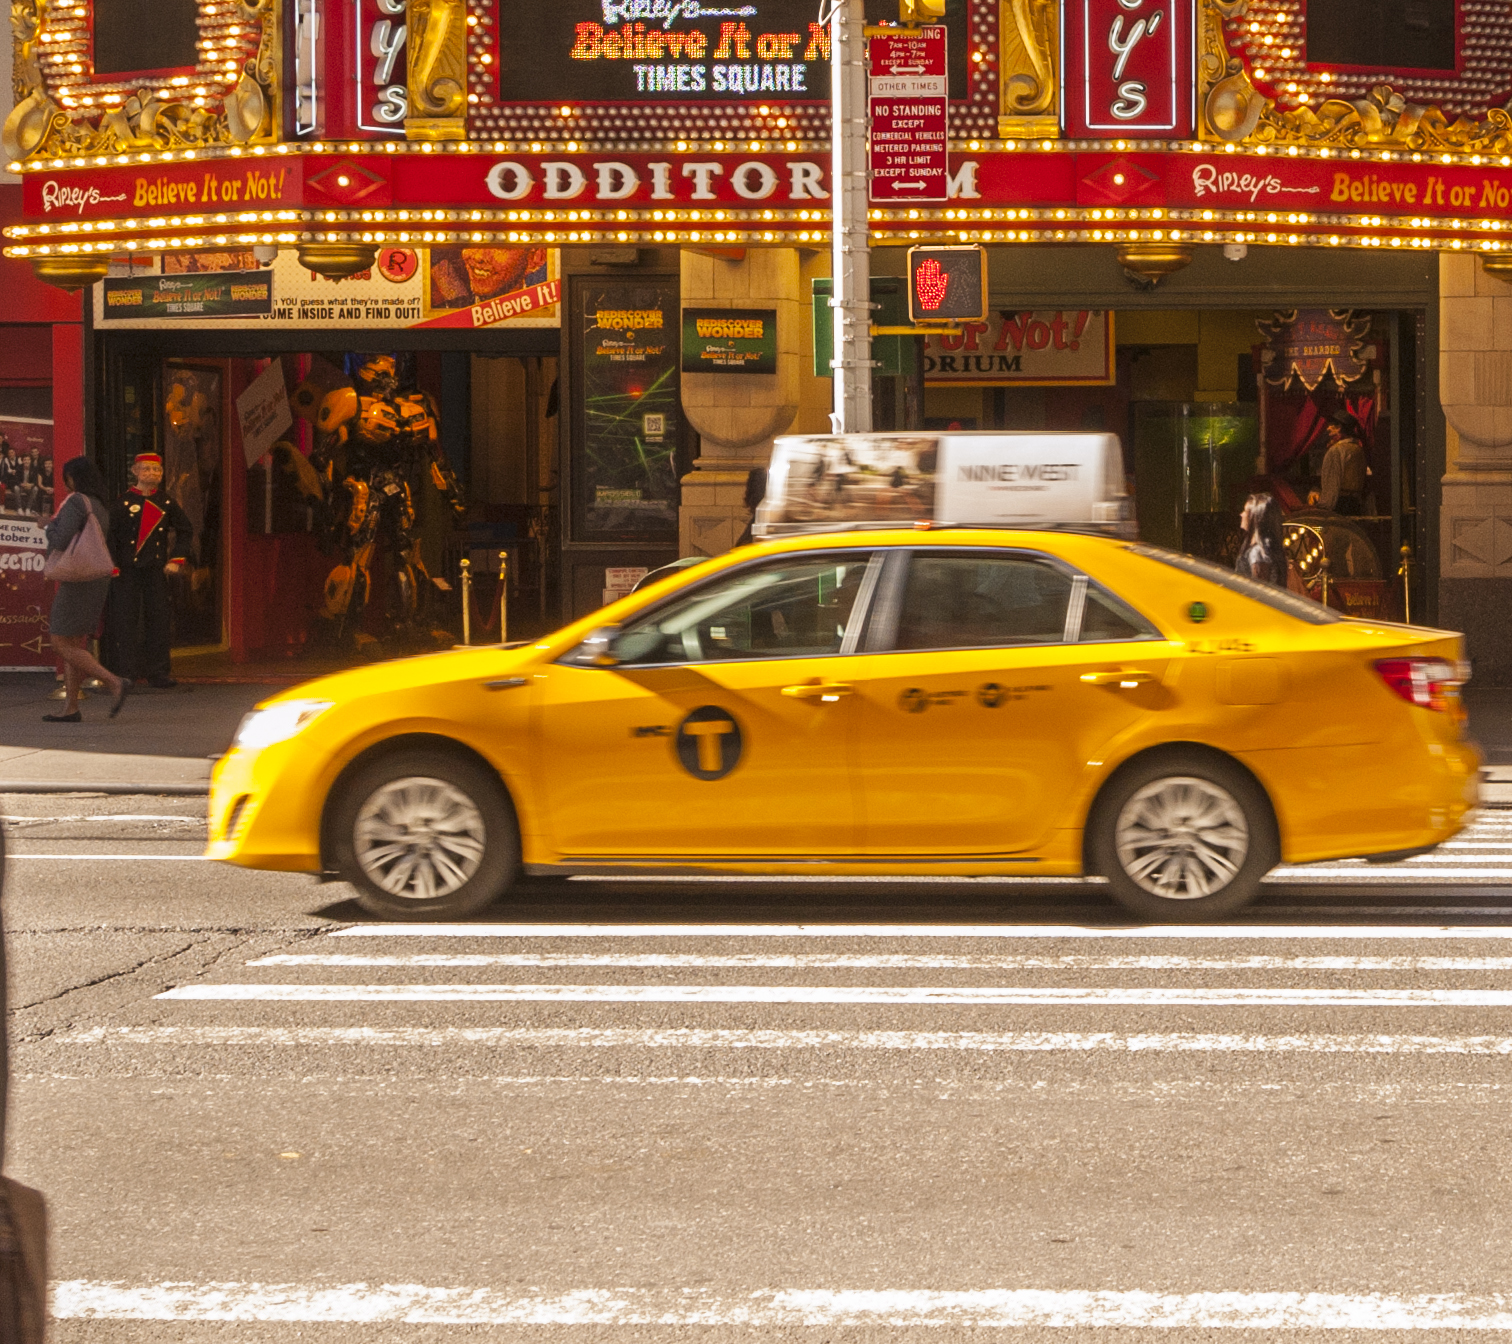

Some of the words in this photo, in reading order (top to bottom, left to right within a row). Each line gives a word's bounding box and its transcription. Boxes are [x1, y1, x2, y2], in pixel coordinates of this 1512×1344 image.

[569, 21, 708, 61] Believe
[713, 21, 750, 61] It
[755, 30, 802, 60] or
[632, 63, 706, 92] TIMES
[712, 63, 809, 94] SQUARE
[878, 82, 907, 92] OTHER
[911, 82, 939, 91] TIMES
[875, 105, 889, 116] NO
[892, 105, 942, 116] STANDING
[891, 119, 925, 128] EXCEPT
[133, 176, 197, 207] Believe
[201, 173, 218, 203] It
[221, 178, 241, 202] or
[244, 168, 286, 202] Not!
[1329, 171, 1417, 203] Believe
[1422, 176, 1446, 205] It
[1449, 183, 1476, 208] or
[471, 295, 533, 327] Believe
[535, 281, 559, 302] It!
[297, 307, 336, 320] INSIDE
[338, 307, 362, 320] AND
[365, 307, 391, 320] FIND
[394, 307, 421, 320] OUT!
[696, 318, 764, 329] REDISCOVER
[697, 327, 764, 339] WONDER
